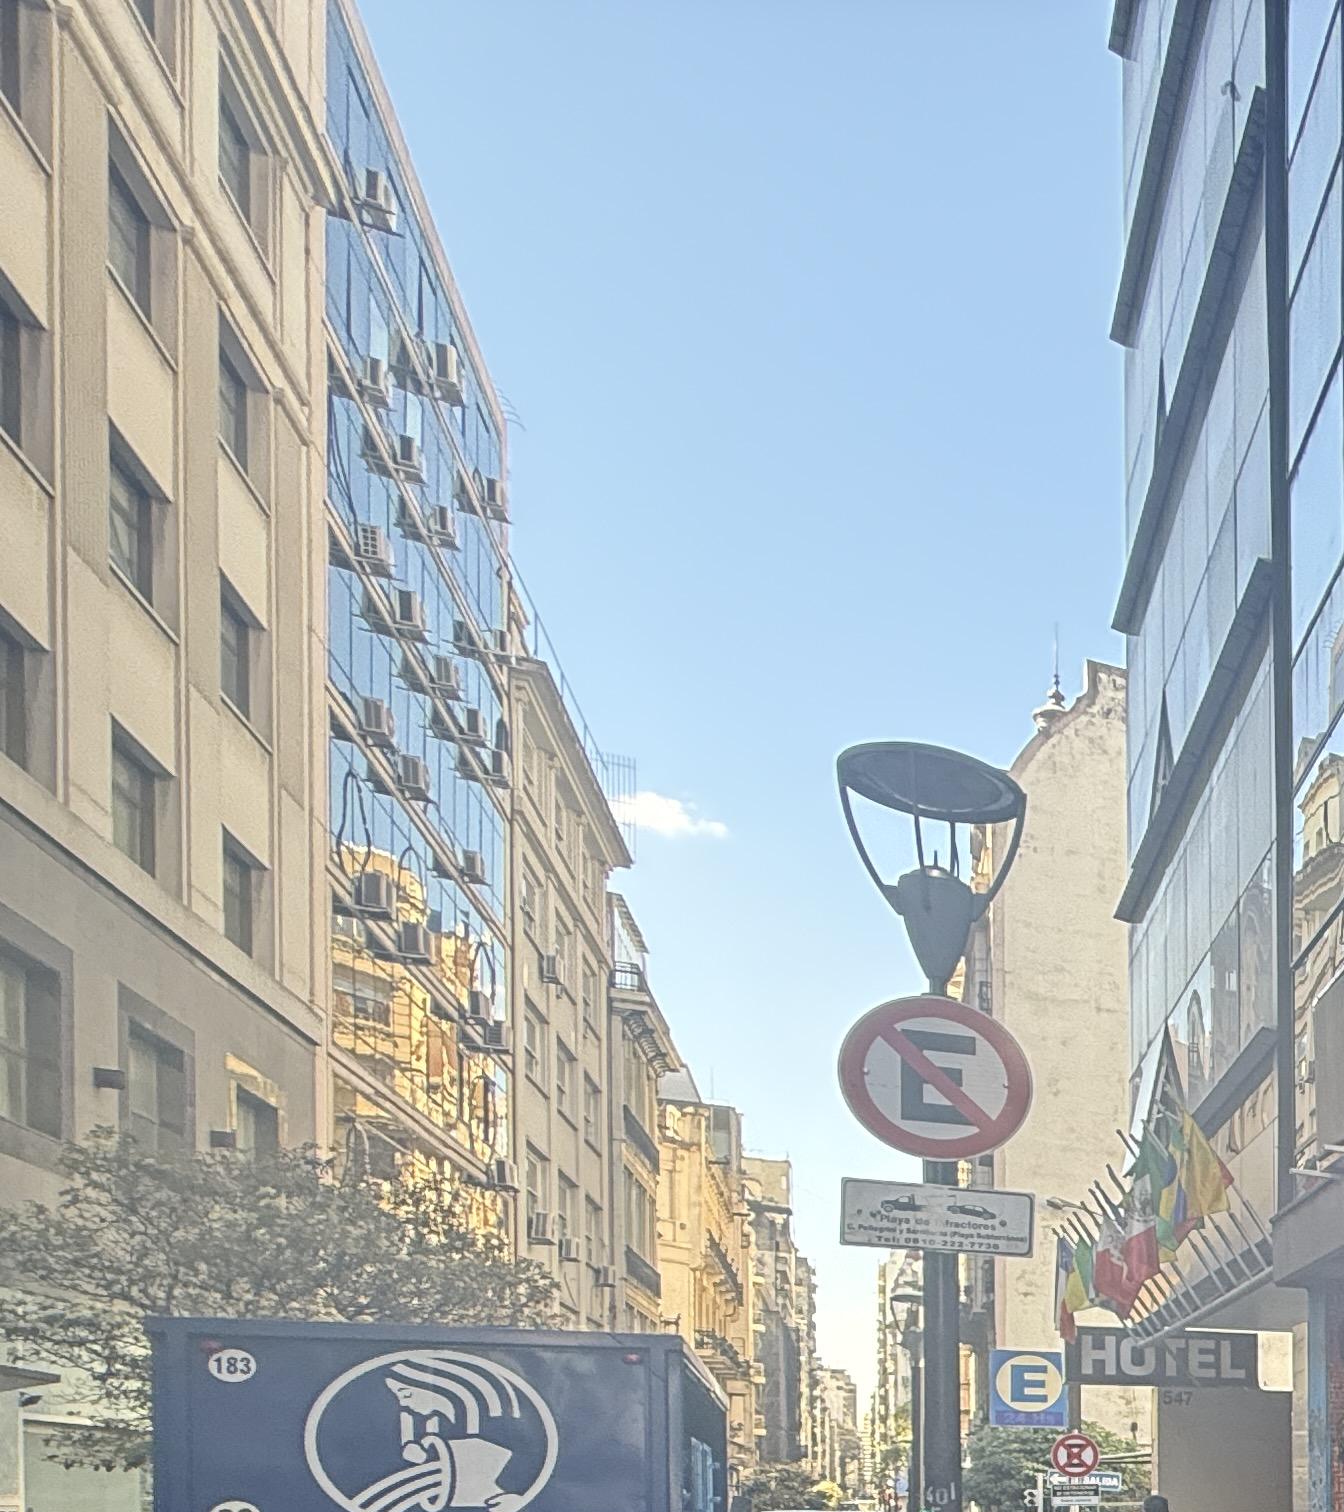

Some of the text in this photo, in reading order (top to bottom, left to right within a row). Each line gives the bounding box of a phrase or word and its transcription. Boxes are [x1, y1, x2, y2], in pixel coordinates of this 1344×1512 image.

[901, 1028, 976, 1126] E
[880, 1214, 910, 1225] Playa
[213, 1356, 252, 1375] 183
[1081, 1334, 1246, 1379] HOTEL
[1011, 1364, 1048, 1403] E
[1163, 1391, 1193, 1405] 547
